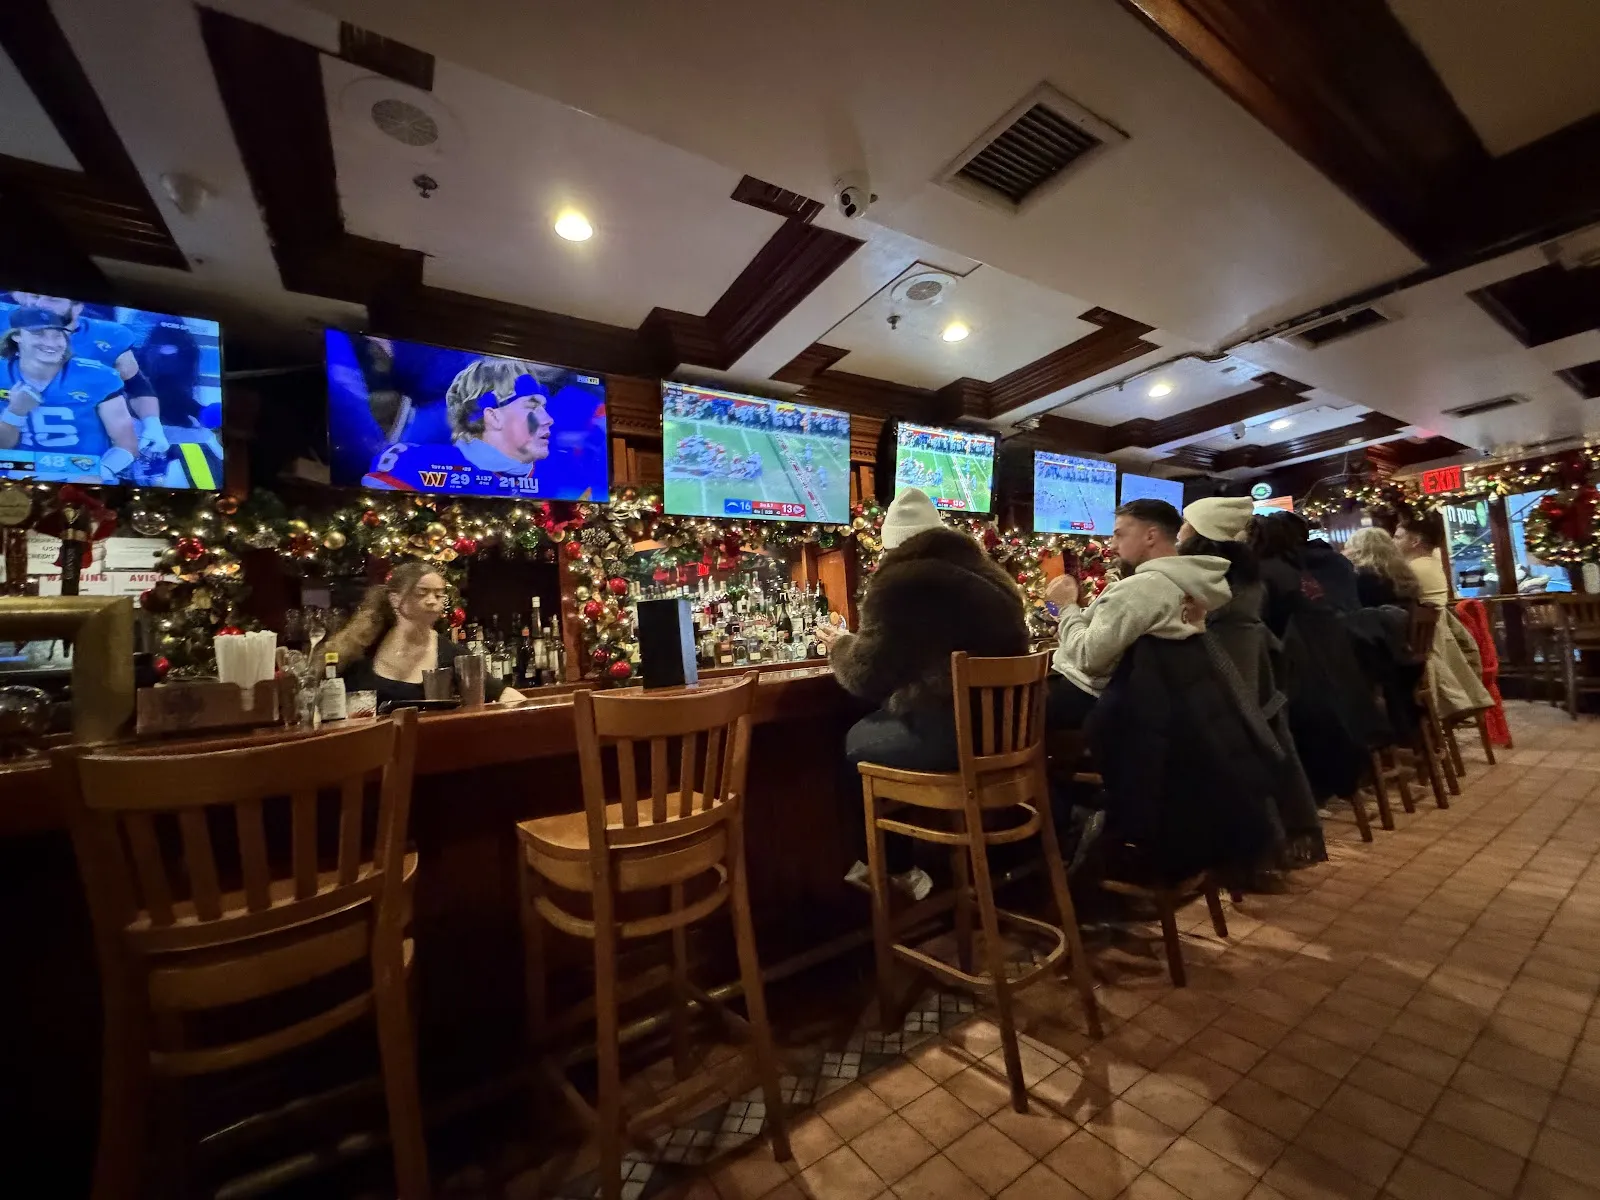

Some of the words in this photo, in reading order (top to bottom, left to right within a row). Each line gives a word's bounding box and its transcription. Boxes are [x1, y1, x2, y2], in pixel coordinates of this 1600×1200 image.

[41, 455, 66, 468] 48
[377, 443, 408, 472] 6
[450, 473, 470, 485] 29
[499, 476, 515, 488] 21
[1423, 467, 1460, 493] EXIT
[740, 501, 751, 511] 16
[782, 504, 793, 513] 13
[129, 574, 165, 582] AVISO
